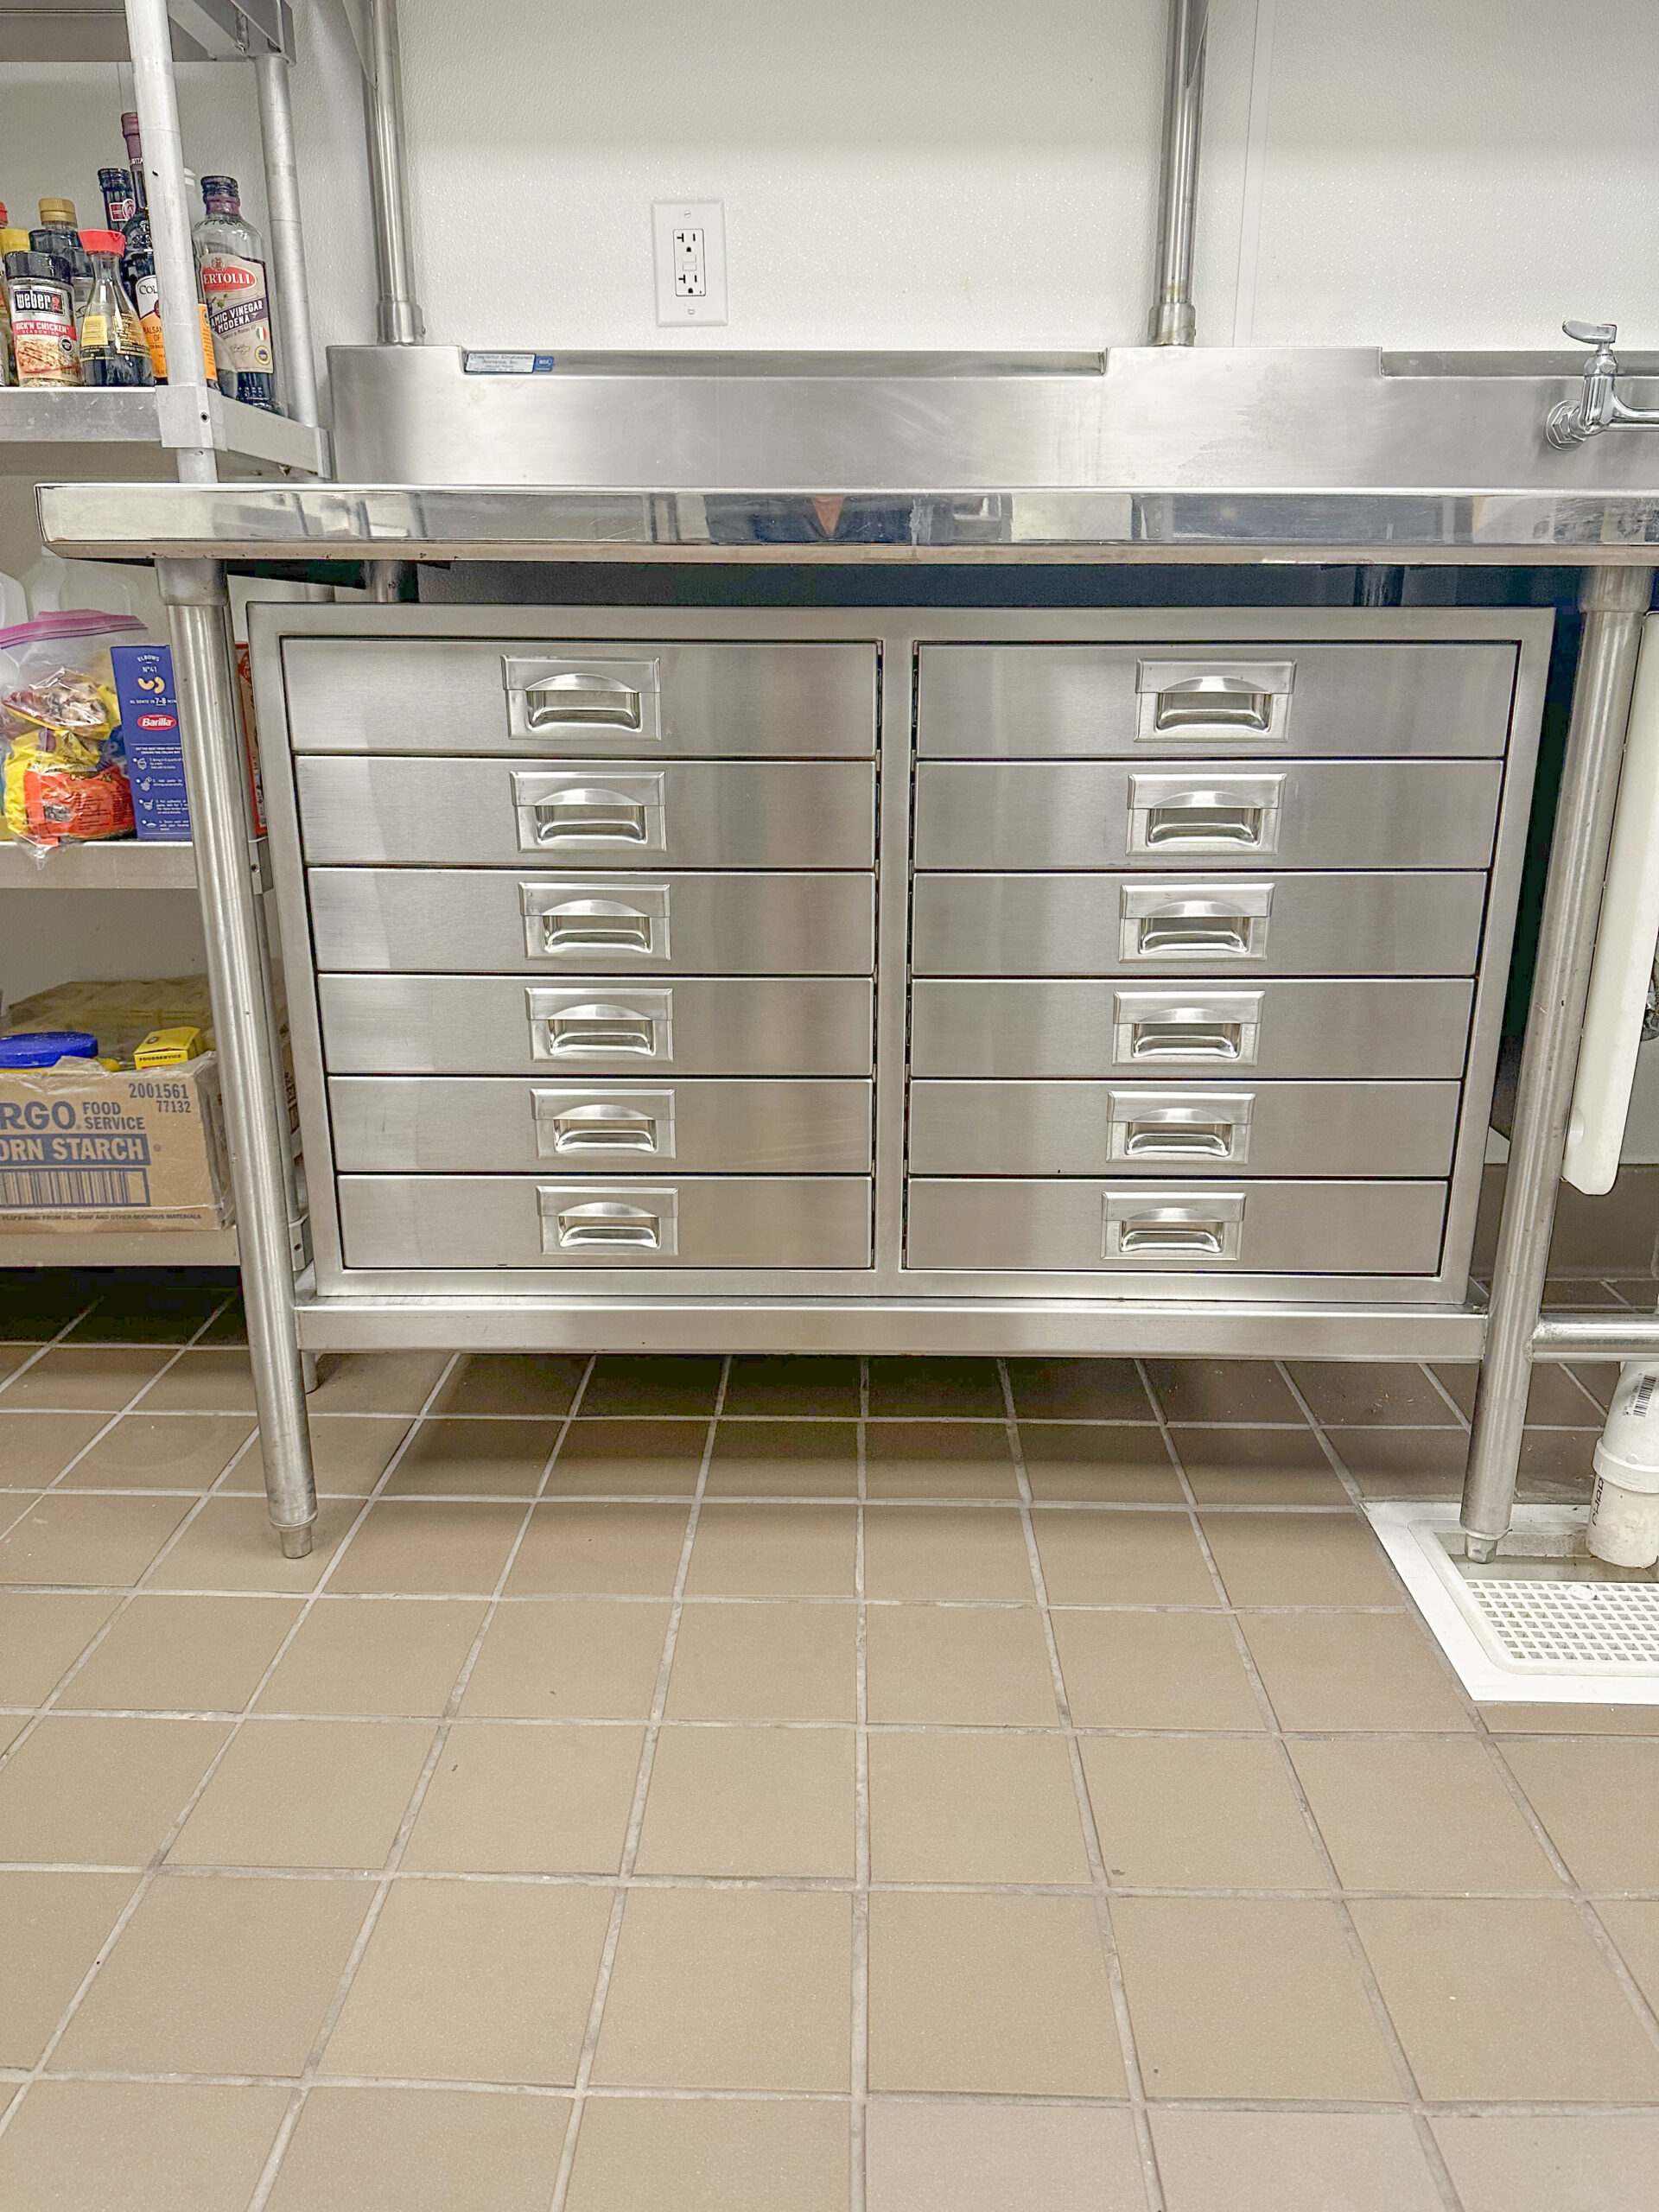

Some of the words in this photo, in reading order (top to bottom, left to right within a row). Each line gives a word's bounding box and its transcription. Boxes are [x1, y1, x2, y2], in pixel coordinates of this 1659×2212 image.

[230, 300, 263, 317] VINEGAR
[36, 322, 67, 334] CHICKEN
[218, 314, 251, 333] MODENA
[142, 717, 173, 727] Barilla
[129, 1082, 188, 1099] 2001561
[82, 1102, 121, 1116] FOOD
[156, 1100, 191, 1114] 77132
[85, 1116, 145, 1130] SERVICE
[52, 1137, 144, 1160] STARCH
